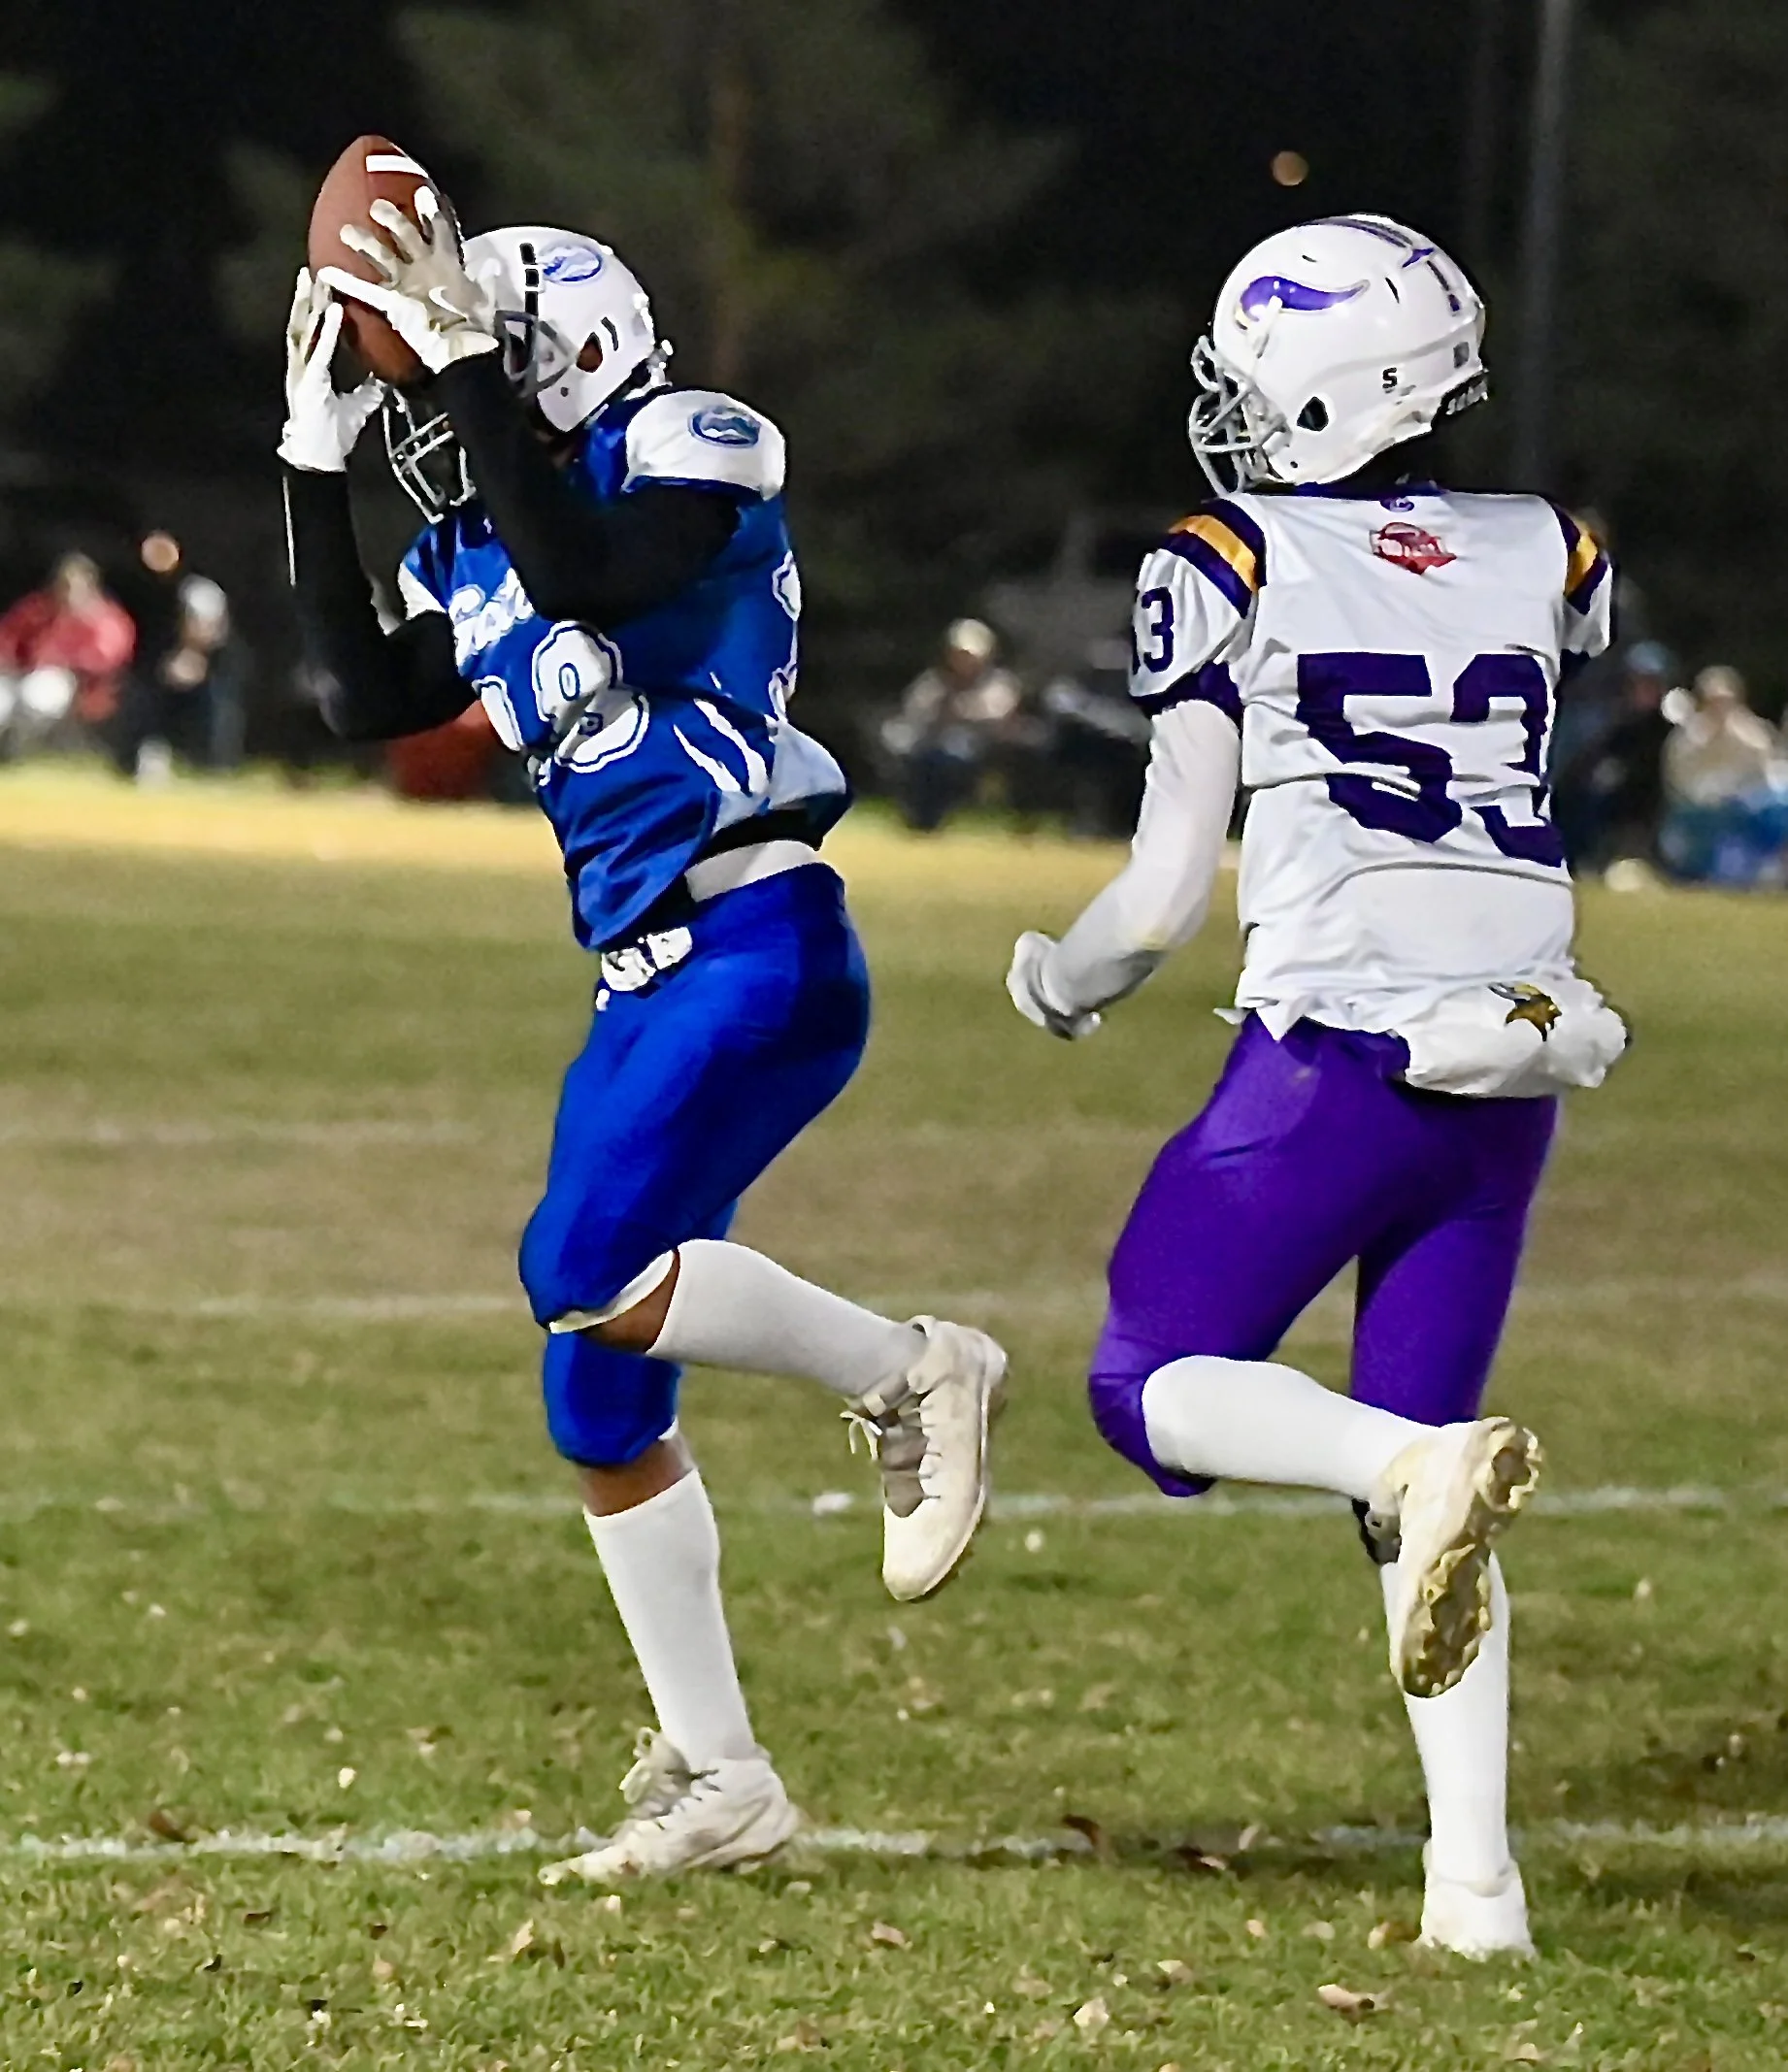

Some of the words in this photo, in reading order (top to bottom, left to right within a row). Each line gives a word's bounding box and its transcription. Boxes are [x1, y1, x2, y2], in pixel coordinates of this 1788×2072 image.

[1381, 367, 1398, 389] S
[1132, 586, 1175, 675] 3
[1297, 651, 1568, 868] 53
